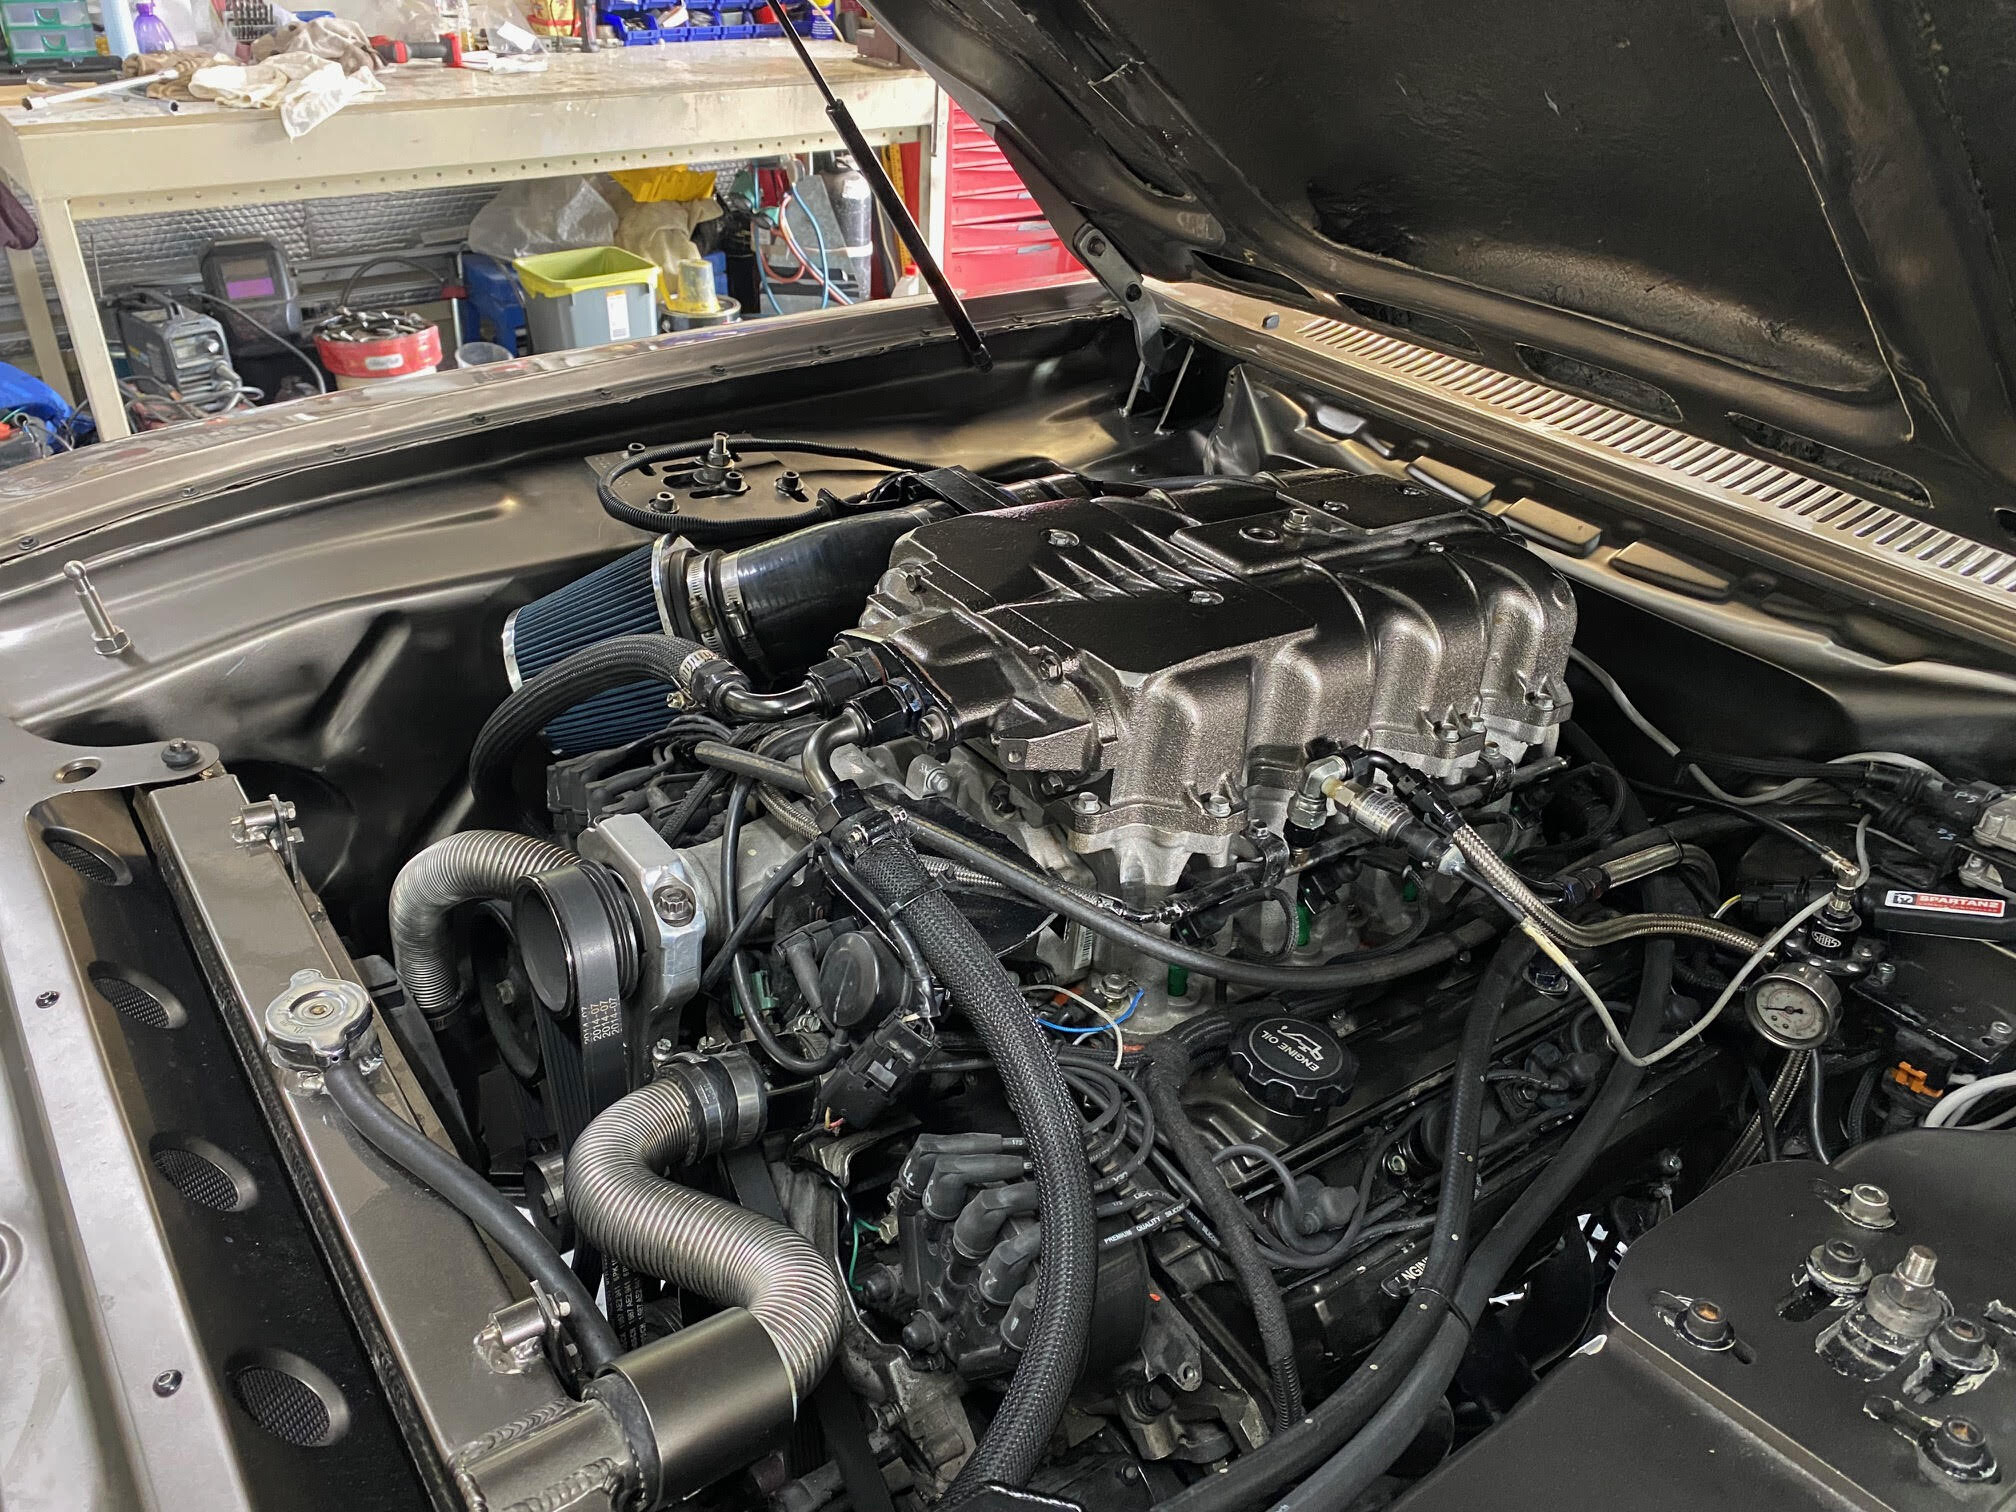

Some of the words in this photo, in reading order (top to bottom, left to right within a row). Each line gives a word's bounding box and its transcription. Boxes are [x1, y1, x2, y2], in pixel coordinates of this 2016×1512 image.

[1919, 894, 1999, 909] SPARTAN2
[590, 1004, 602, 1042] 2014-07
[600, 1000, 611, 1038] 2014-07
[608, 997, 620, 1035] 2014-07
[1260, 1030, 1280, 1045] OIL
[1277, 1042, 1320, 1072] ENGINE
[1103, 1229, 1133, 1245] PREMIUM
[1135, 1215, 1161, 1232] QUALITY
